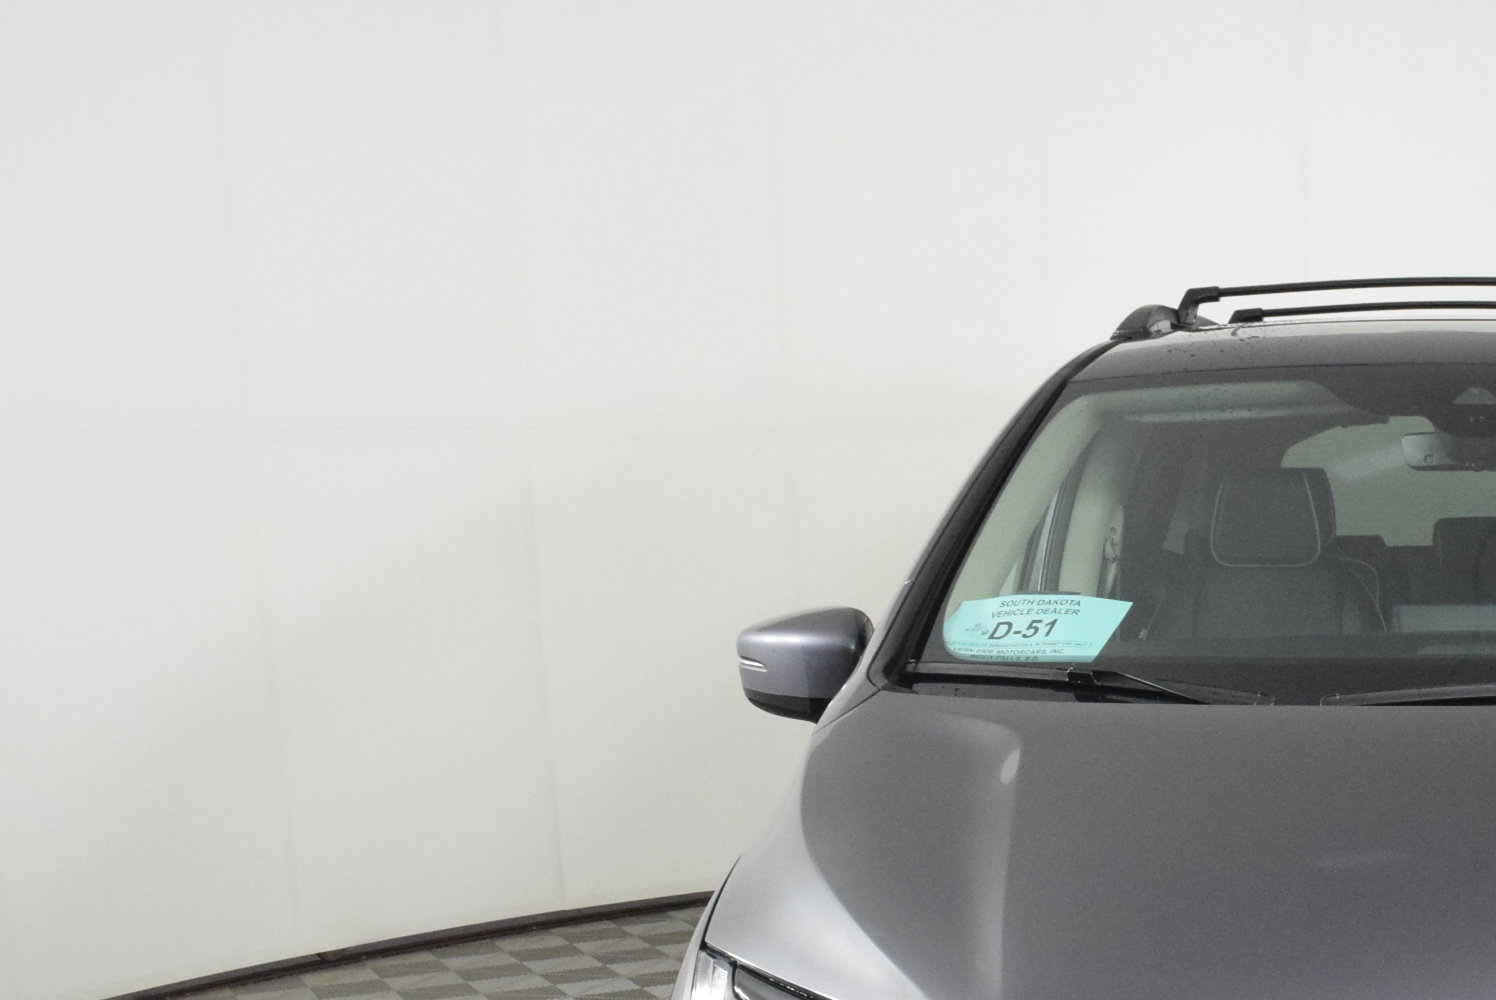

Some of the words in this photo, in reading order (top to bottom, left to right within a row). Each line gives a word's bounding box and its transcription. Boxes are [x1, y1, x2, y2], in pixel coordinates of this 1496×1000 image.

[1000, 599, 1036, 608] SOUTH
[1036, 599, 1081, 607] DAKOTA
[991, 608, 1034, 618] VEHICLE
[1035, 608, 1081, 616] DEALER
[987, 618, 1059, 640] D-51
